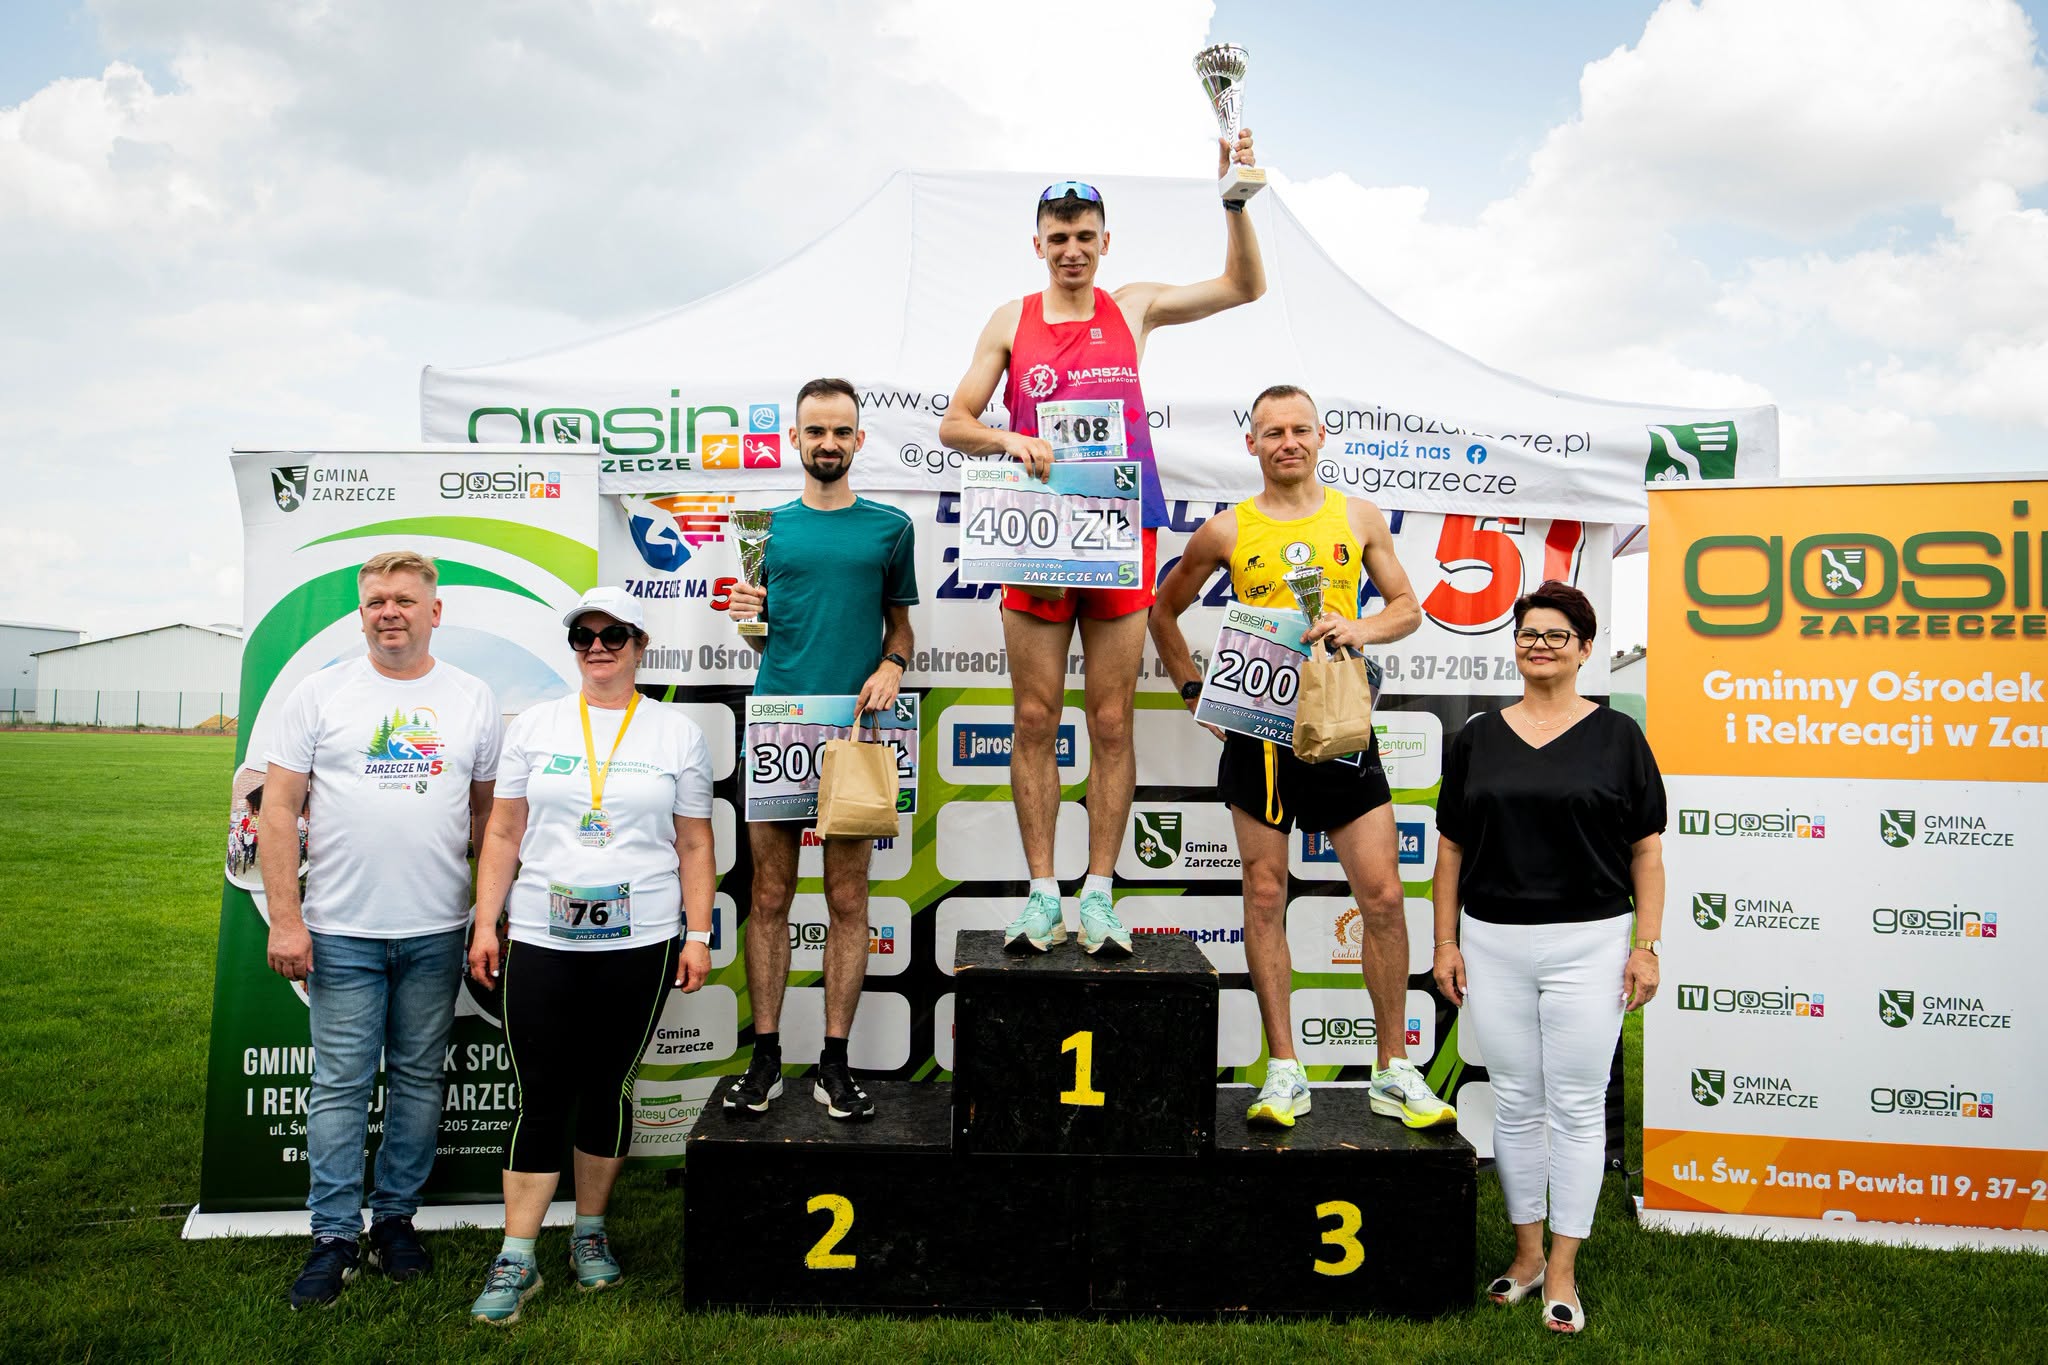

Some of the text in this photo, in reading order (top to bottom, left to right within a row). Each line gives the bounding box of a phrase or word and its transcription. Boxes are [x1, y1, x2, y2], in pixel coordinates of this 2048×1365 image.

[1067, 367, 1137, 381] MARSZAL
[1054, 418, 1110, 443] 108
[1345, 439, 1450, 461] znajdź nas
[602, 459, 692, 473] ZECZE
[967, 468, 1013, 481] gosir
[313, 468, 370, 483] GMINA
[440, 464, 544, 500] gosir
[1317, 460, 1517, 495] @ugzarzecze
[312, 487, 397, 502] ZARZECZE
[967, 508, 1058, 549] 400
[1072, 510, 1134, 550] ZŁ
[1023, 564, 1136, 585] ZARZECZE NA 5
[1684, 500, 2048, 636] gosi
[684, 578, 708, 598] NA
[1800, 615, 2047, 636] ZARZECZE
[1210, 649, 1300, 706] 200
[1385, 655, 1405, 682] 9,
[1410, 655, 1488, 681] 37-205
[1703, 669, 2046, 708] Gminny Ośrodek
[751, 701, 797, 716] gosir
[1253, 725, 1293, 742] ZARZE
[1726, 713, 1736, 744] i
[1746, 714, 1934, 755] Rekreacji
[1944, 724, 1976, 747] w
[365, 760, 444, 776] ZARZECZE NA 5
[1682, 808, 1811, 836] TV gosir
[1924, 815, 1987, 830] GMINA
[1185, 842, 1228, 853] Gmina
[1923, 831, 2015, 847] ZARZECZE
[1184, 857, 1241, 868] Zarzecze
[569, 902, 609, 926] 76
[1734, 898, 1794, 914] GMINA
[1734, 914, 1821, 931] ZARZECZE
[1873, 904, 1981, 934] gosir
[1901, 929, 1962, 938] ZARZECZE
[1682, 985, 1809, 1013] TV gosir
[1923, 996, 1985, 1012] GMINA
[1739, 1008, 1793, 1016] ZARZECZE
[1922, 1012, 2012, 1029] ZARZECZE
[656, 1027, 701, 1040] Gmina
[1302, 1018, 1377, 1046] gos
[656, 1041, 715, 1055] Zarzecze
[1329, 1038, 1379, 1046] ZARZECZ
[1060, 1030, 1106, 1107] 1
[1733, 1076, 1792, 1091] GMINA
[247, 1087, 253, 1116] I
[1733, 1091, 1819, 1109] ZARZECZE
[1871, 1084, 1978, 1114] gosir
[1899, 1109, 1959, 1118] ZARZECZE
[269, 1119, 512, 1136] ul. Św -205 Zarze
[1672, 1160, 1705, 1182] ul.
[1711, 1157, 1757, 1185] Św.
[1765, 1165, 1832, 1190] Jana
[1838, 1169, 1924, 1196] Pawła
[1954, 1175, 1978, 1201] 9,
[803, 1193, 857, 1271] 2
[1312, 1199, 1366, 1276] 3
